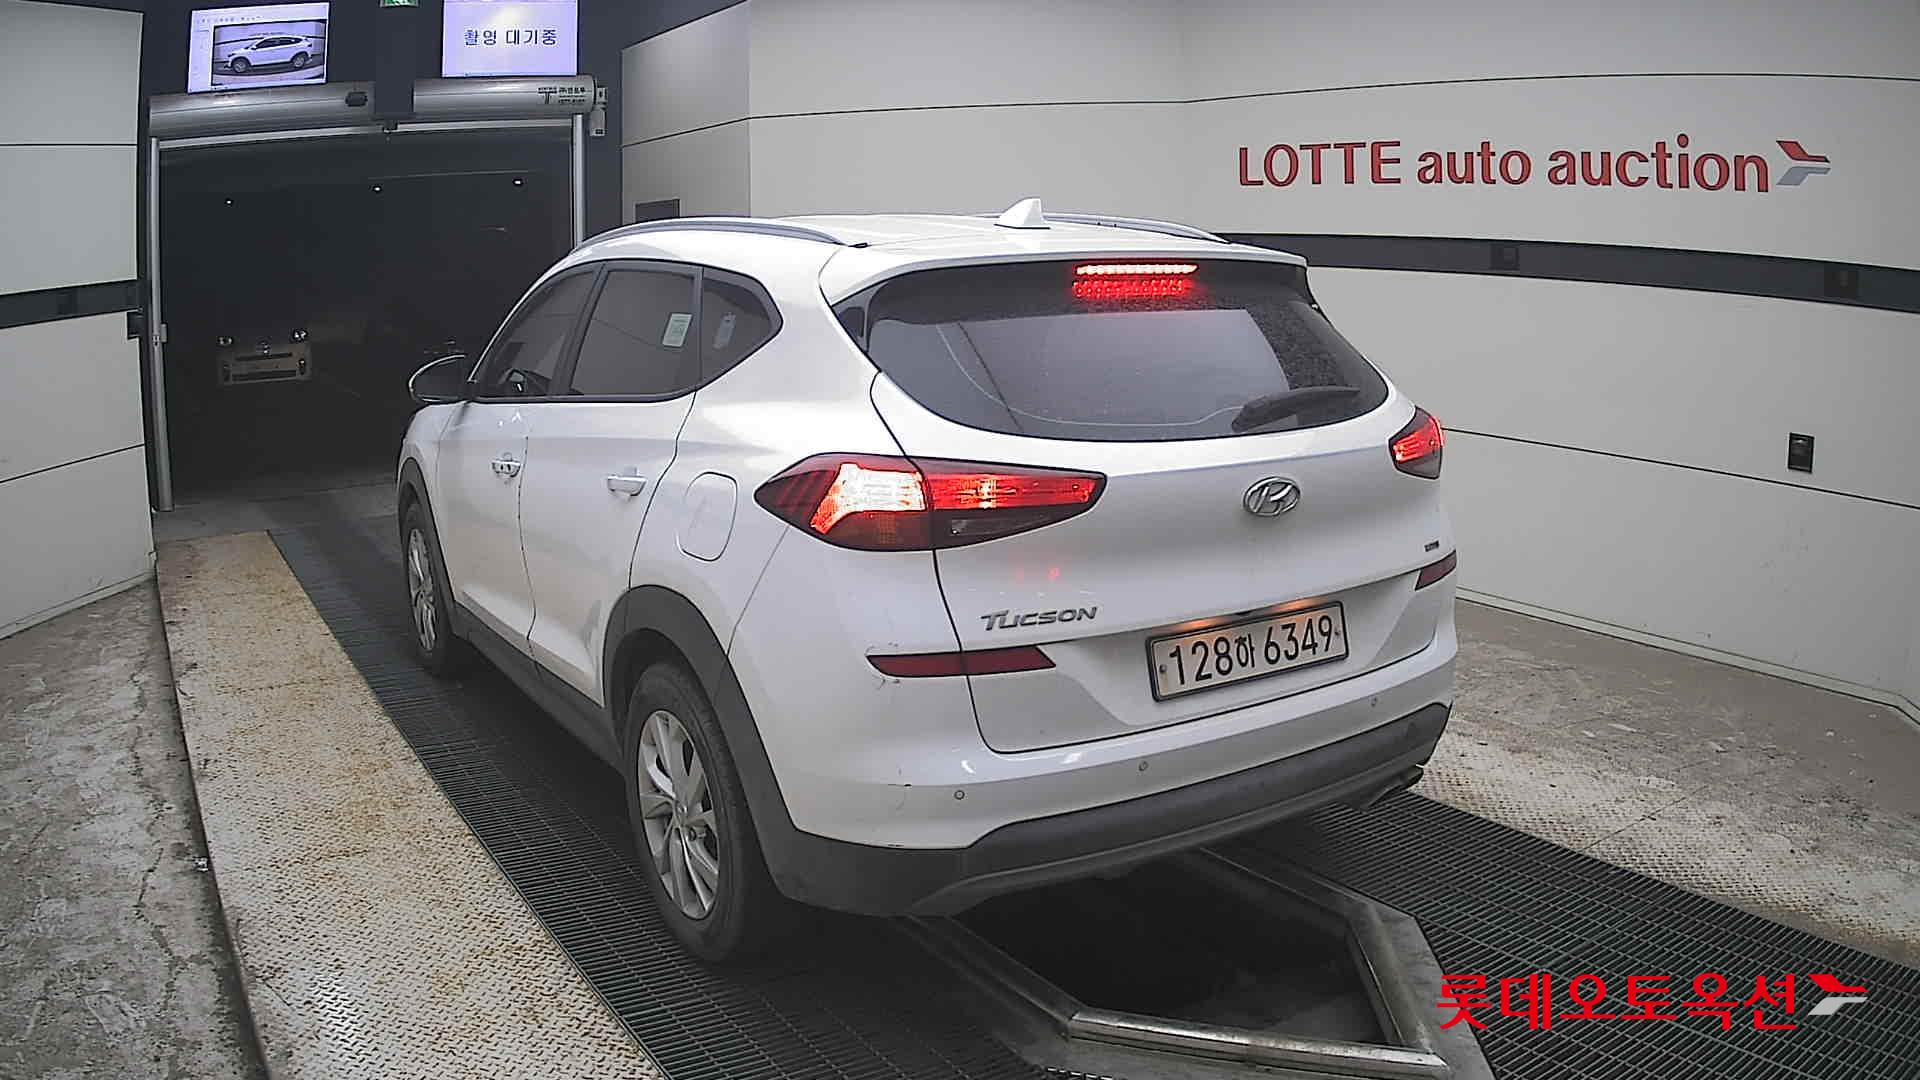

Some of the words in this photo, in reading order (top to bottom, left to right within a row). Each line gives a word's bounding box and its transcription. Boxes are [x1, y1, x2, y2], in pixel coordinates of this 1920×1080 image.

[505, 28, 557, 46] 대기중
[1238, 140, 1401, 187] LOTTE
[1416, 140, 1532, 186] auto
[1547, 133, 1770, 193] auction
[981, 606, 1097, 631] TUCSON
[1169, 633, 1255, 685] 128하
[1264, 615, 1333, 665] 6349
